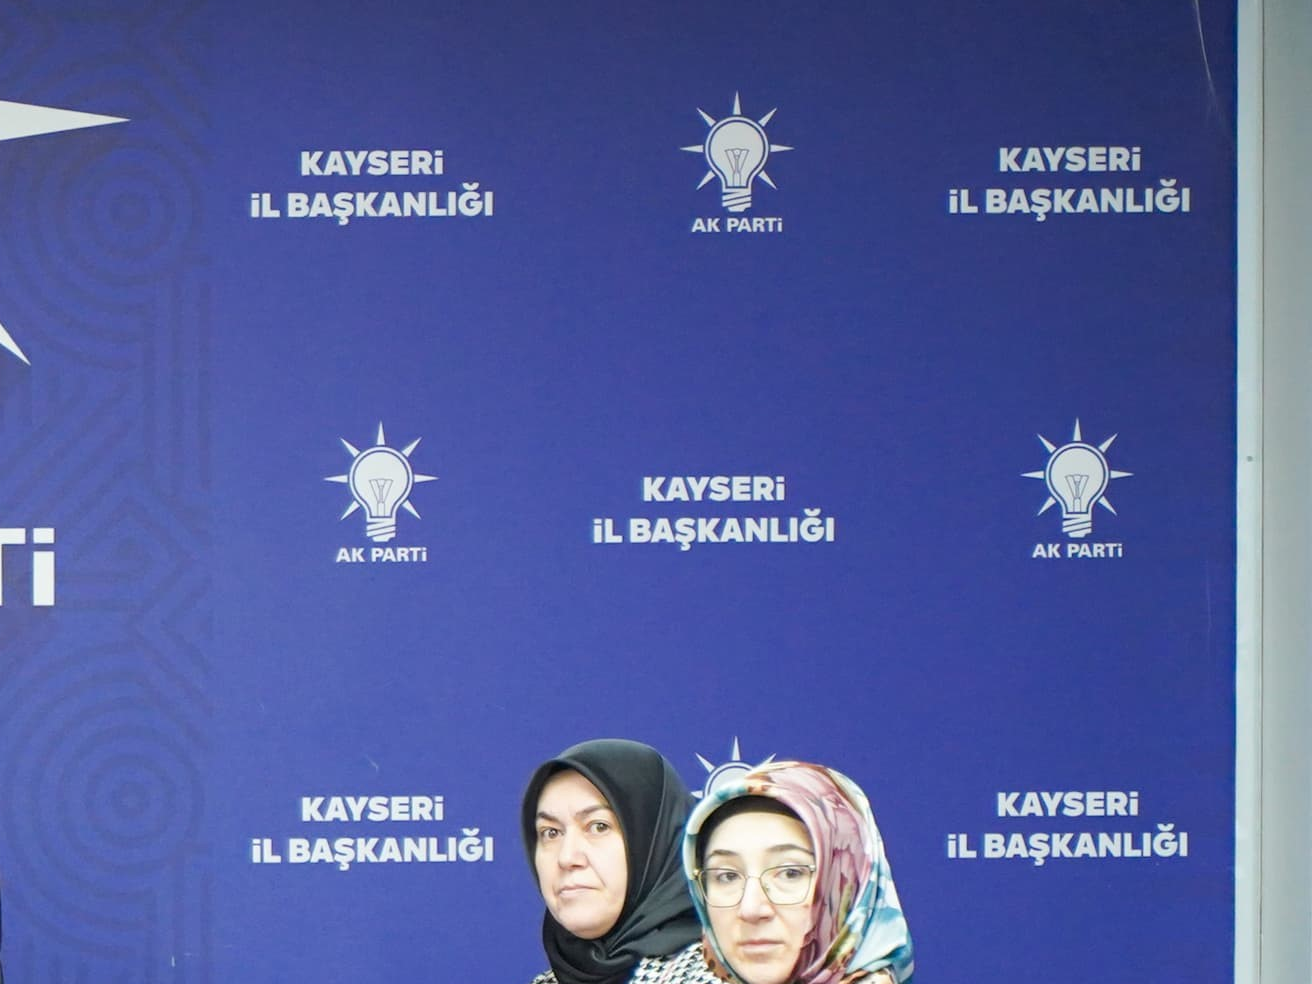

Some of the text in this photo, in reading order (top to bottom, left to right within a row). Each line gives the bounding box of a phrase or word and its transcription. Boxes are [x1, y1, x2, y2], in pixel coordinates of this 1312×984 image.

[287, 182, 494, 226] BAŞKANLIĞI
[985, 178, 1190, 222] BAŞKANLIĞI
[691, 217, 721, 233] AK
[629, 508, 835, 552] BAŞKANLIĞI
[1032, 543, 1061, 558] AK
[335, 547, 365, 563] AK
[288, 827, 494, 871] BAŞKANLIĞI
[983, 823, 1188, 866] BAŞKANLIĞI
